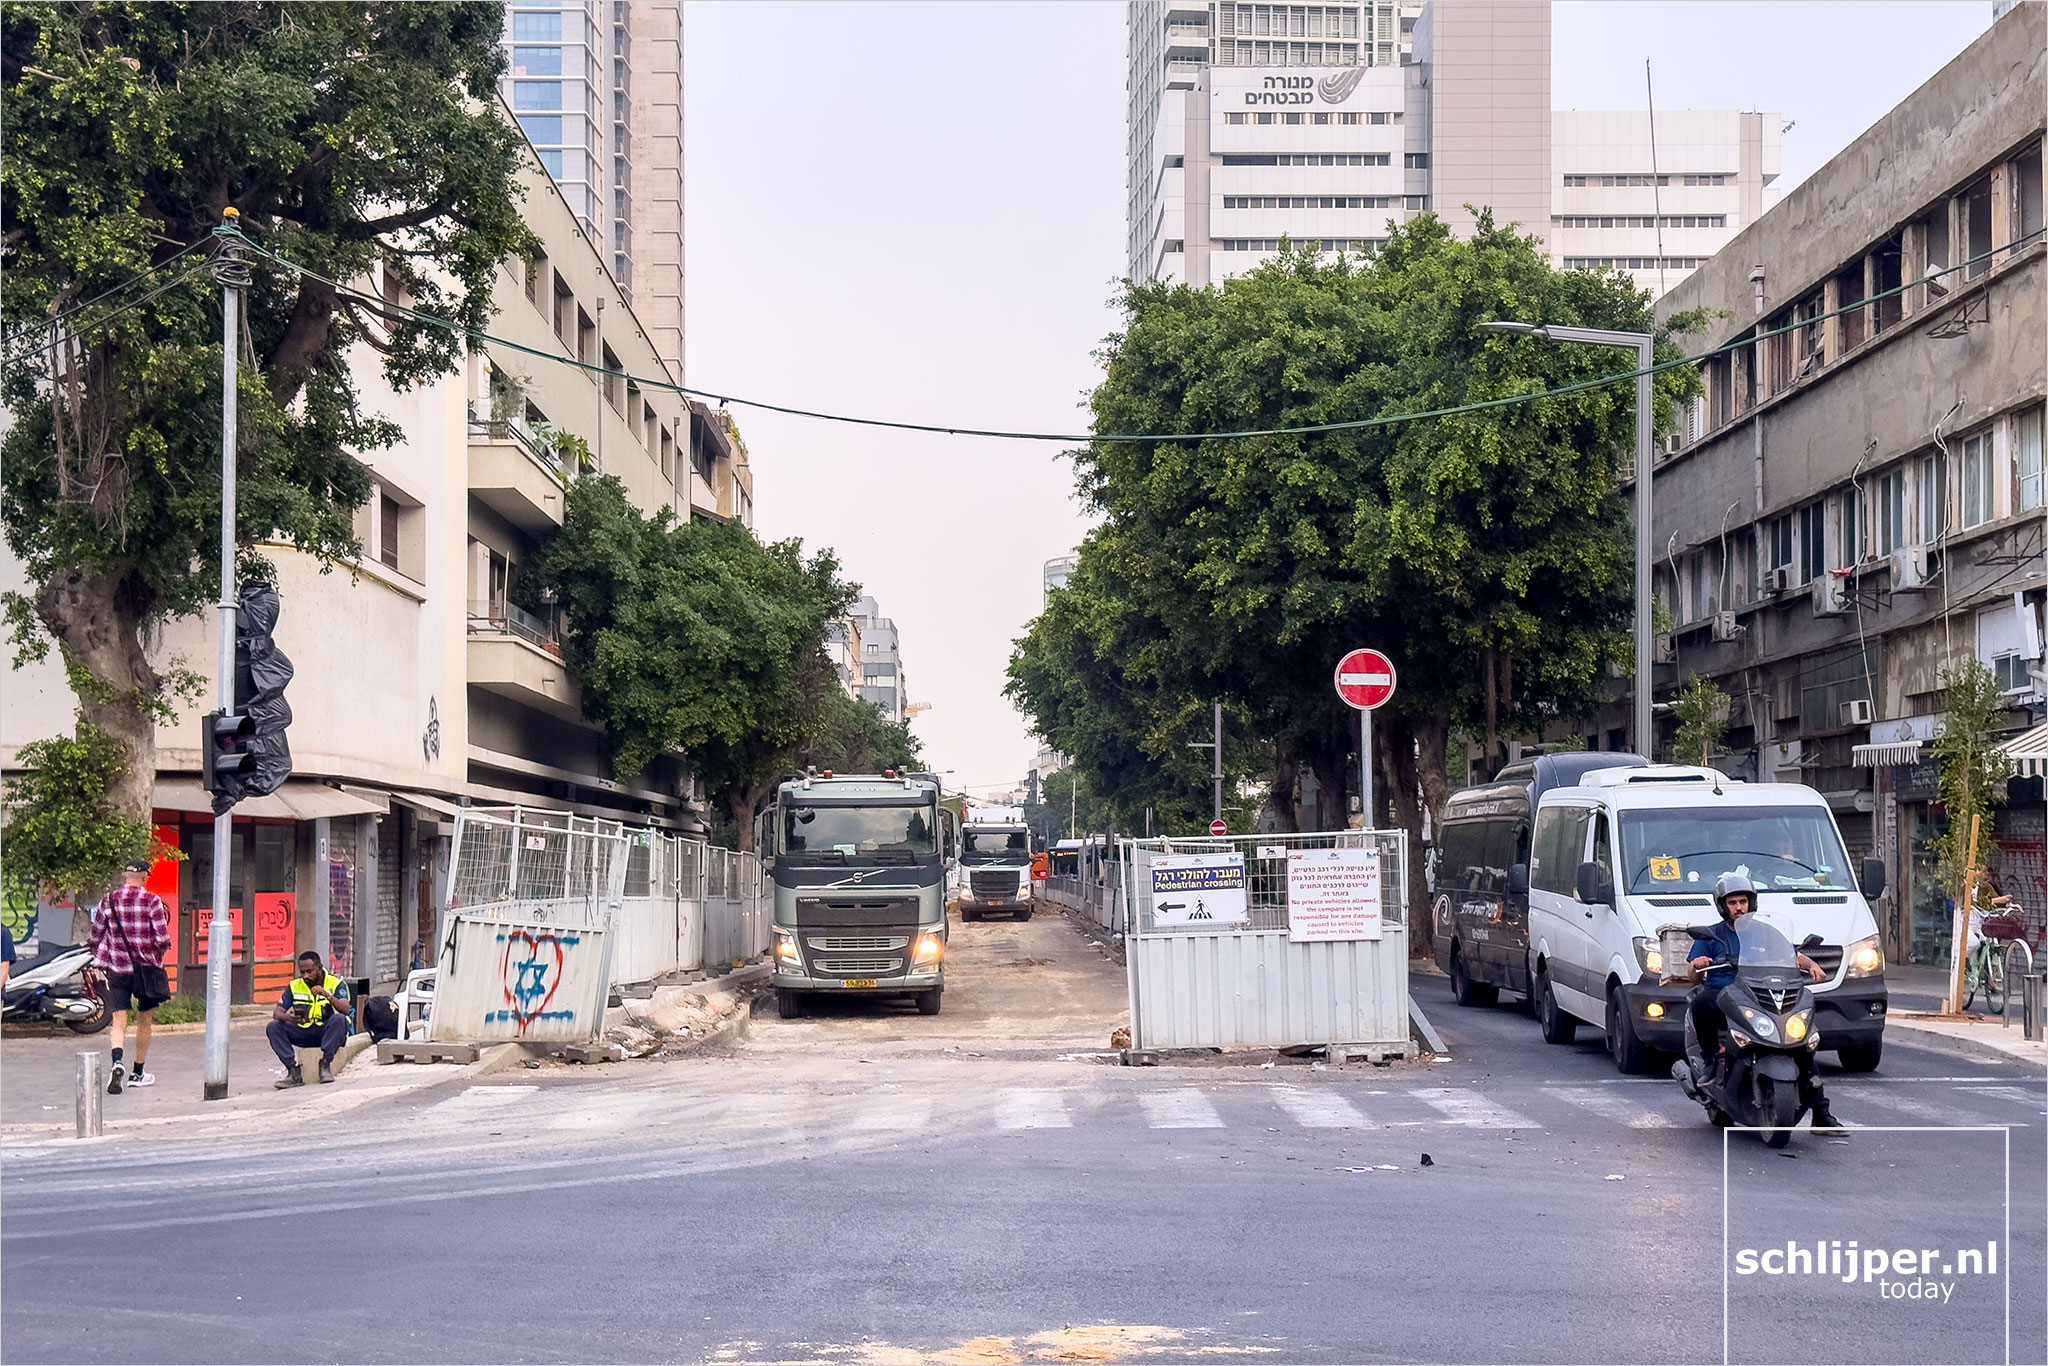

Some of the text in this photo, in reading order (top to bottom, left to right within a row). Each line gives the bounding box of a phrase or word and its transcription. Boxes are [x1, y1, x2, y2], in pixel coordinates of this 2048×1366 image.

[1264, 76, 1314, 89] מנורה
[1245, 92, 1314, 104] מבטחים
[1156, 868, 1240, 881] מעבר להולכי רגל
[1155, 879, 1243, 890] Pedestrian crossing
[258, 910, 284, 927] ליברין
